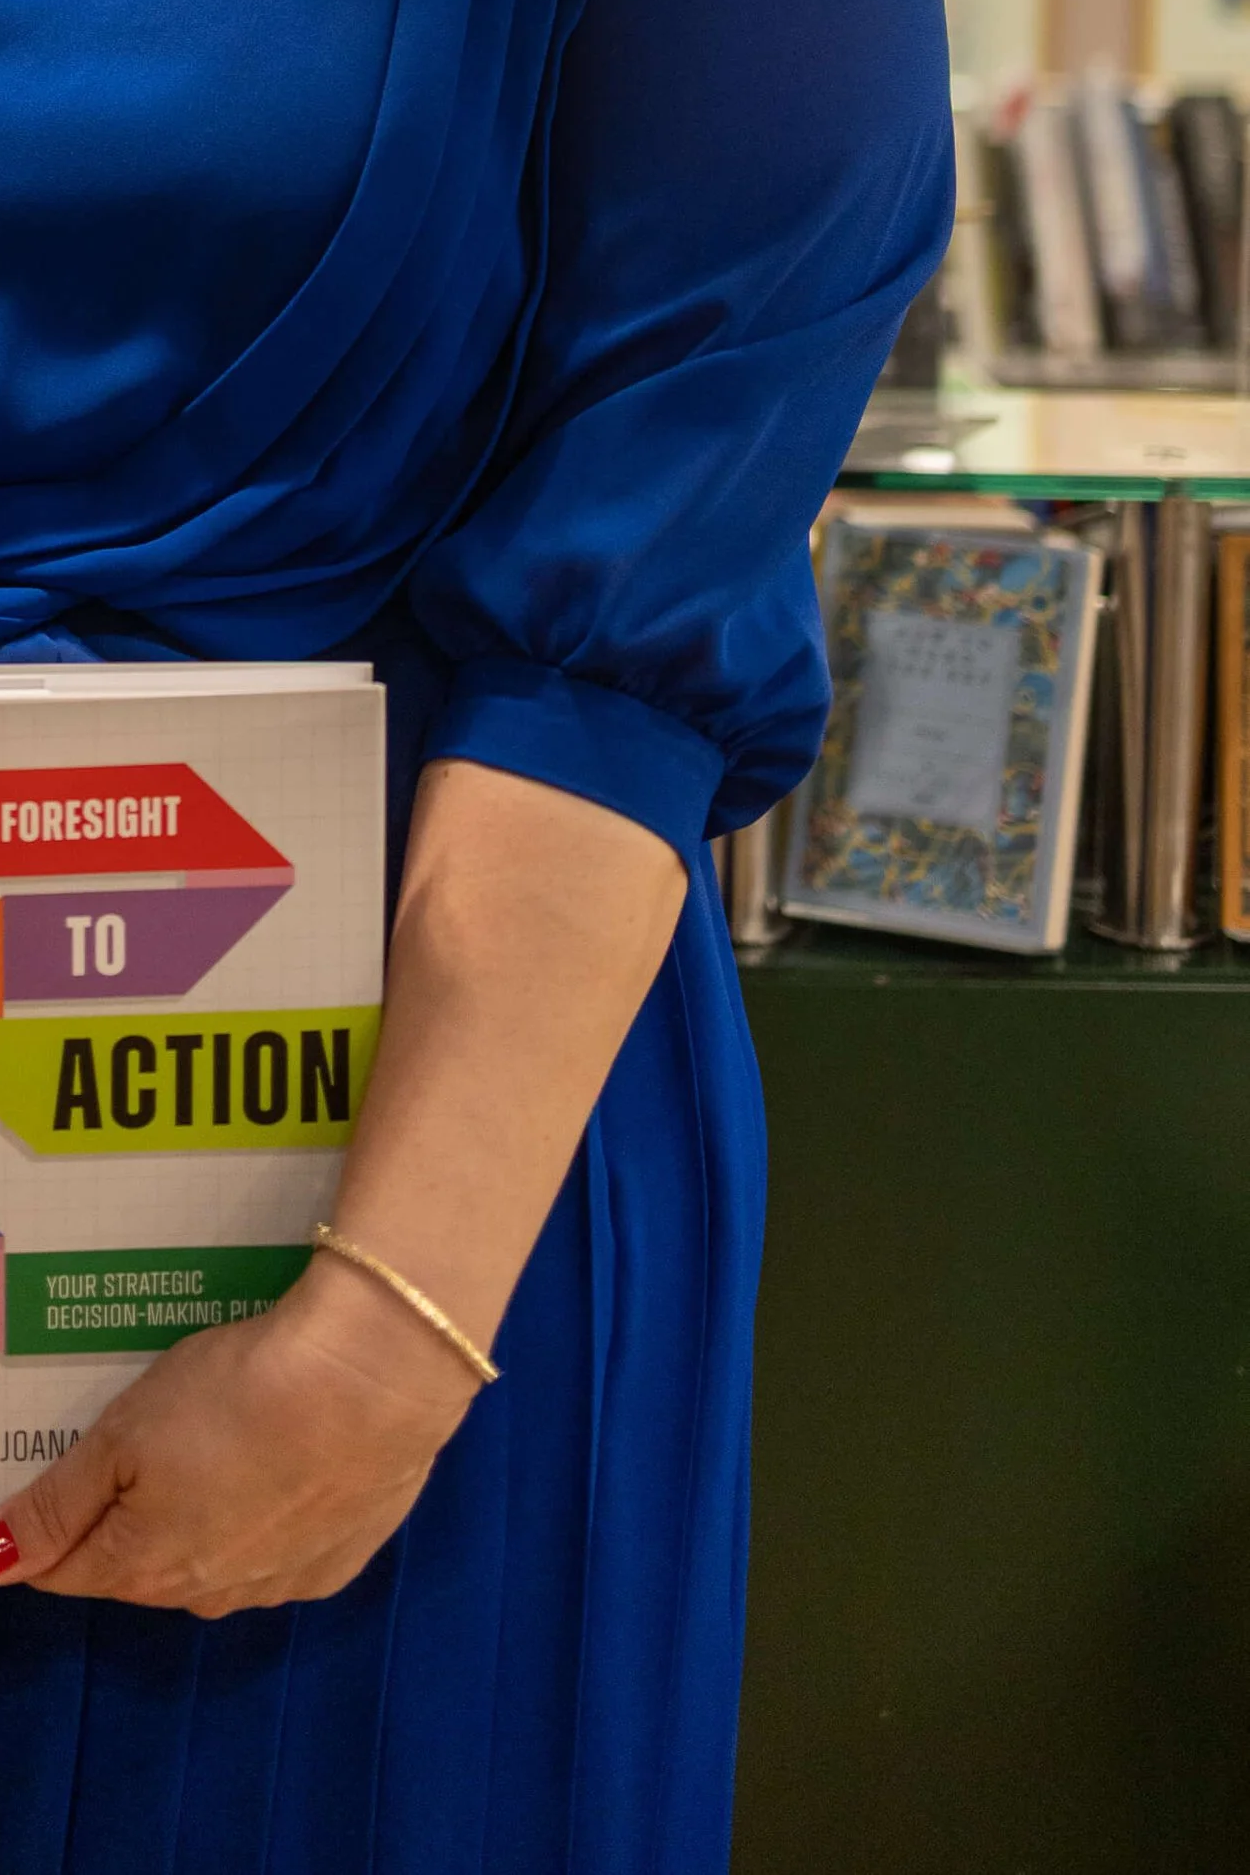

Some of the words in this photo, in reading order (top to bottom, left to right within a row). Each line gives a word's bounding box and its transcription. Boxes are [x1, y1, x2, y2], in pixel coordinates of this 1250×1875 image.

[0, 796, 181, 843] FORESIGHT
[65, 913, 126, 977] TO
[53, 1028, 350, 1131] ACTION
[46, 1274, 97, 1299] YOUR
[104, 1270, 204, 1297] STRATEGIC
[46, 1301, 222, 1329] DECISION-MAKING
[230, 1298, 280, 1324] PLAY
